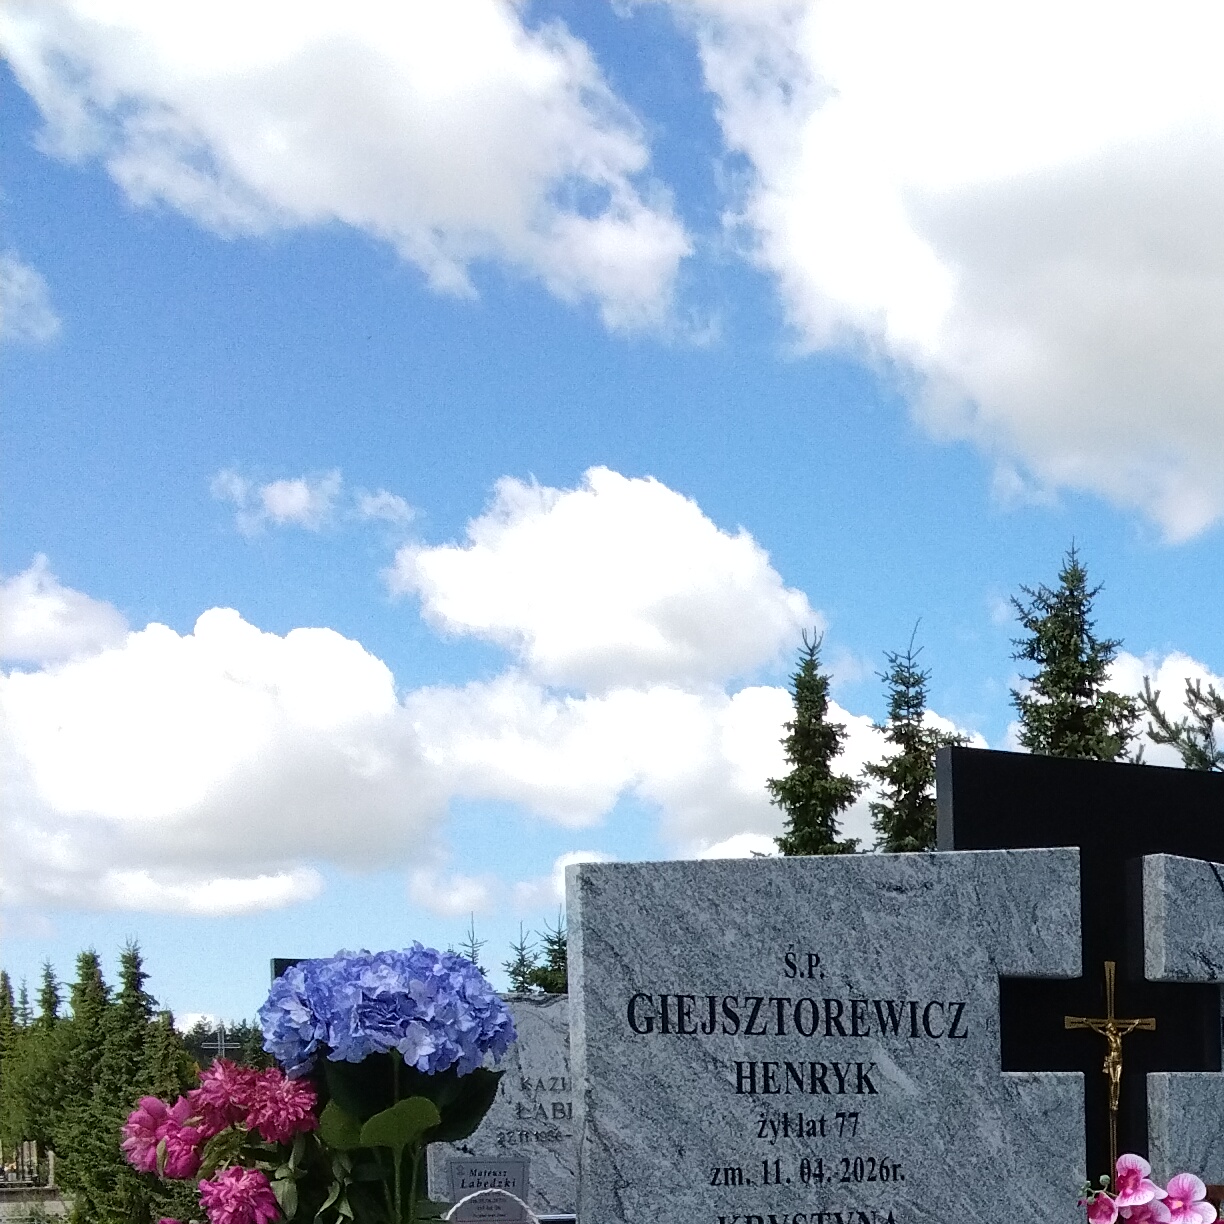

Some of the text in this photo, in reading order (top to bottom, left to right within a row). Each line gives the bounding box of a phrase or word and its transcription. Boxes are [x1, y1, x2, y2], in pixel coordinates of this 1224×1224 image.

[626, 993, 969, 1039] GIEJSZTOREWICZ
[735, 1061, 879, 1095] HENRYK
[757, 1112, 860, 1145] żył lat 77
[710, 1166, 752, 1187] zm.
[840, 1156, 906, 1184] 2026r.
